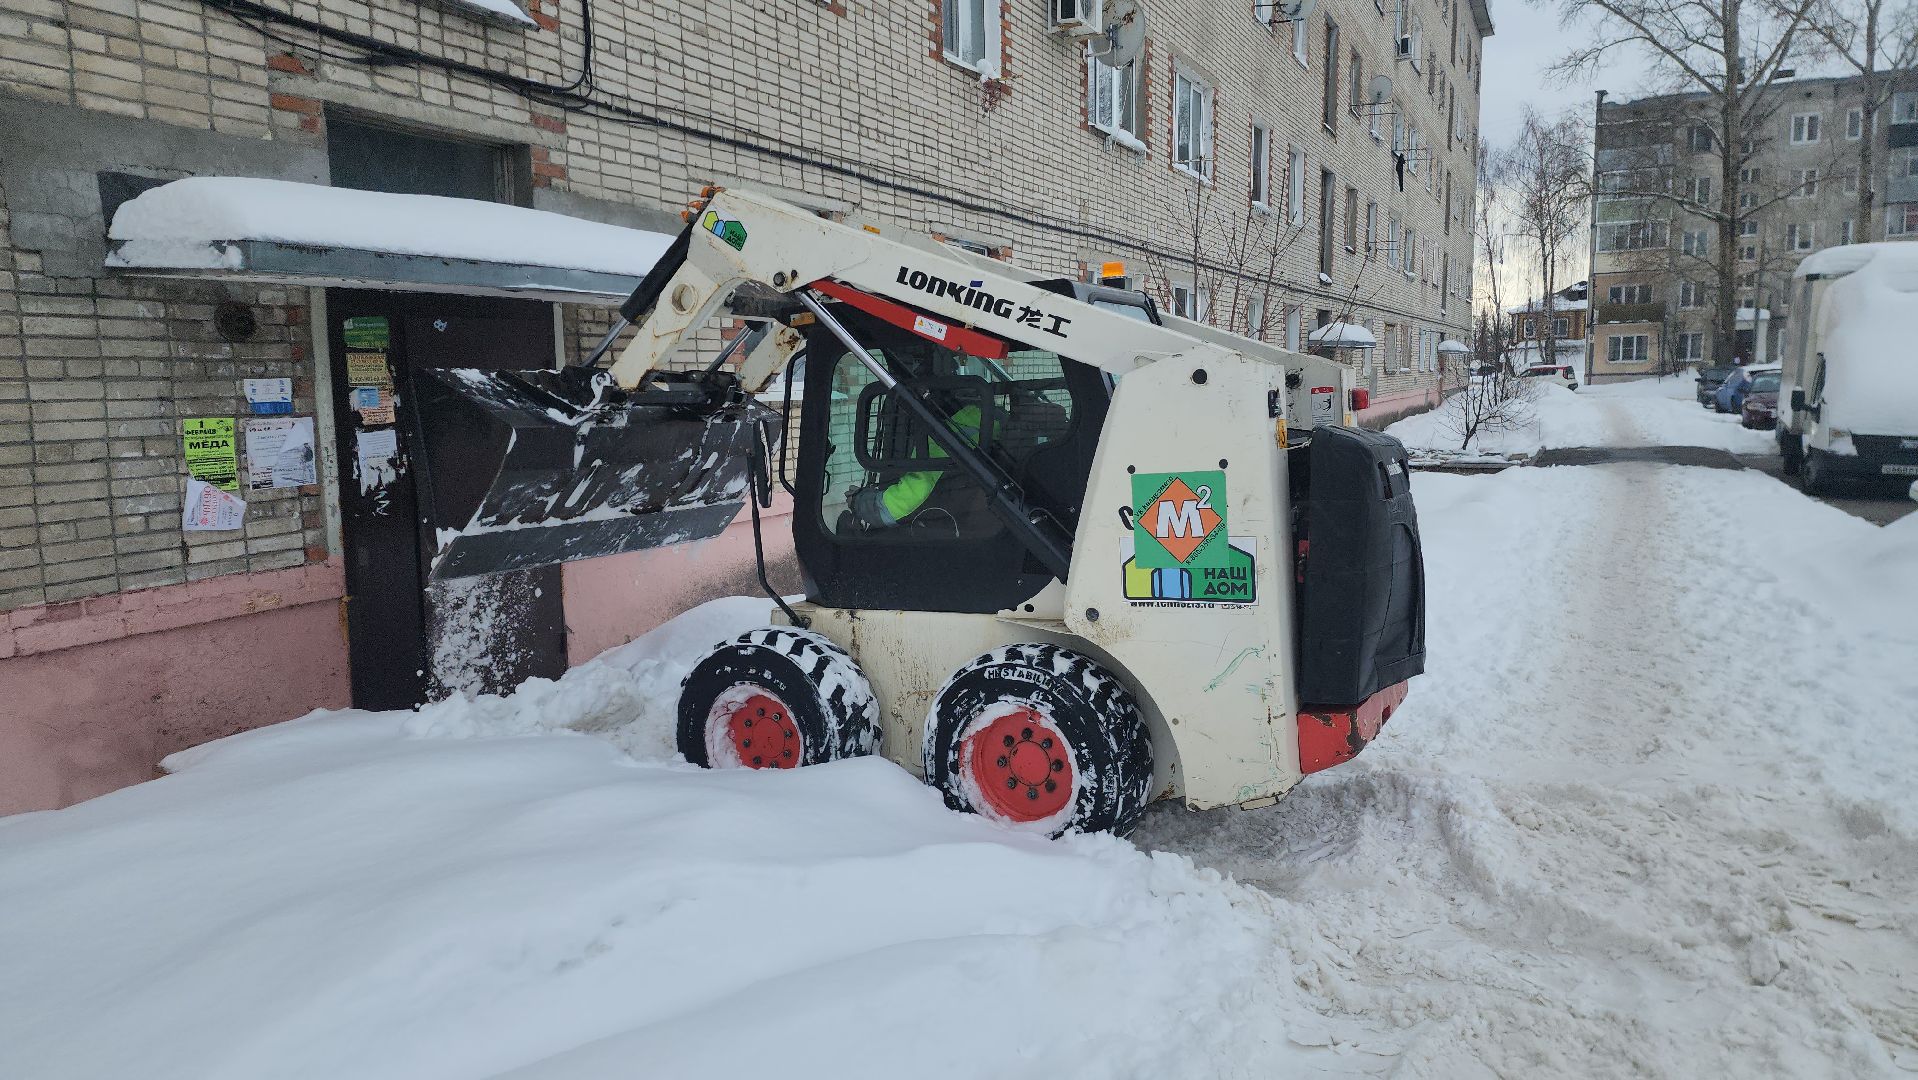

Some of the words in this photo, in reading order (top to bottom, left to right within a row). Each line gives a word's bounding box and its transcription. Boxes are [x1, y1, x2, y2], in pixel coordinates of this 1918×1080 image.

[1016, 305, 1072, 338] 龙工
[1204, 568, 1247, 580] НАШ
[1204, 582, 1247, 595] ДОМ
